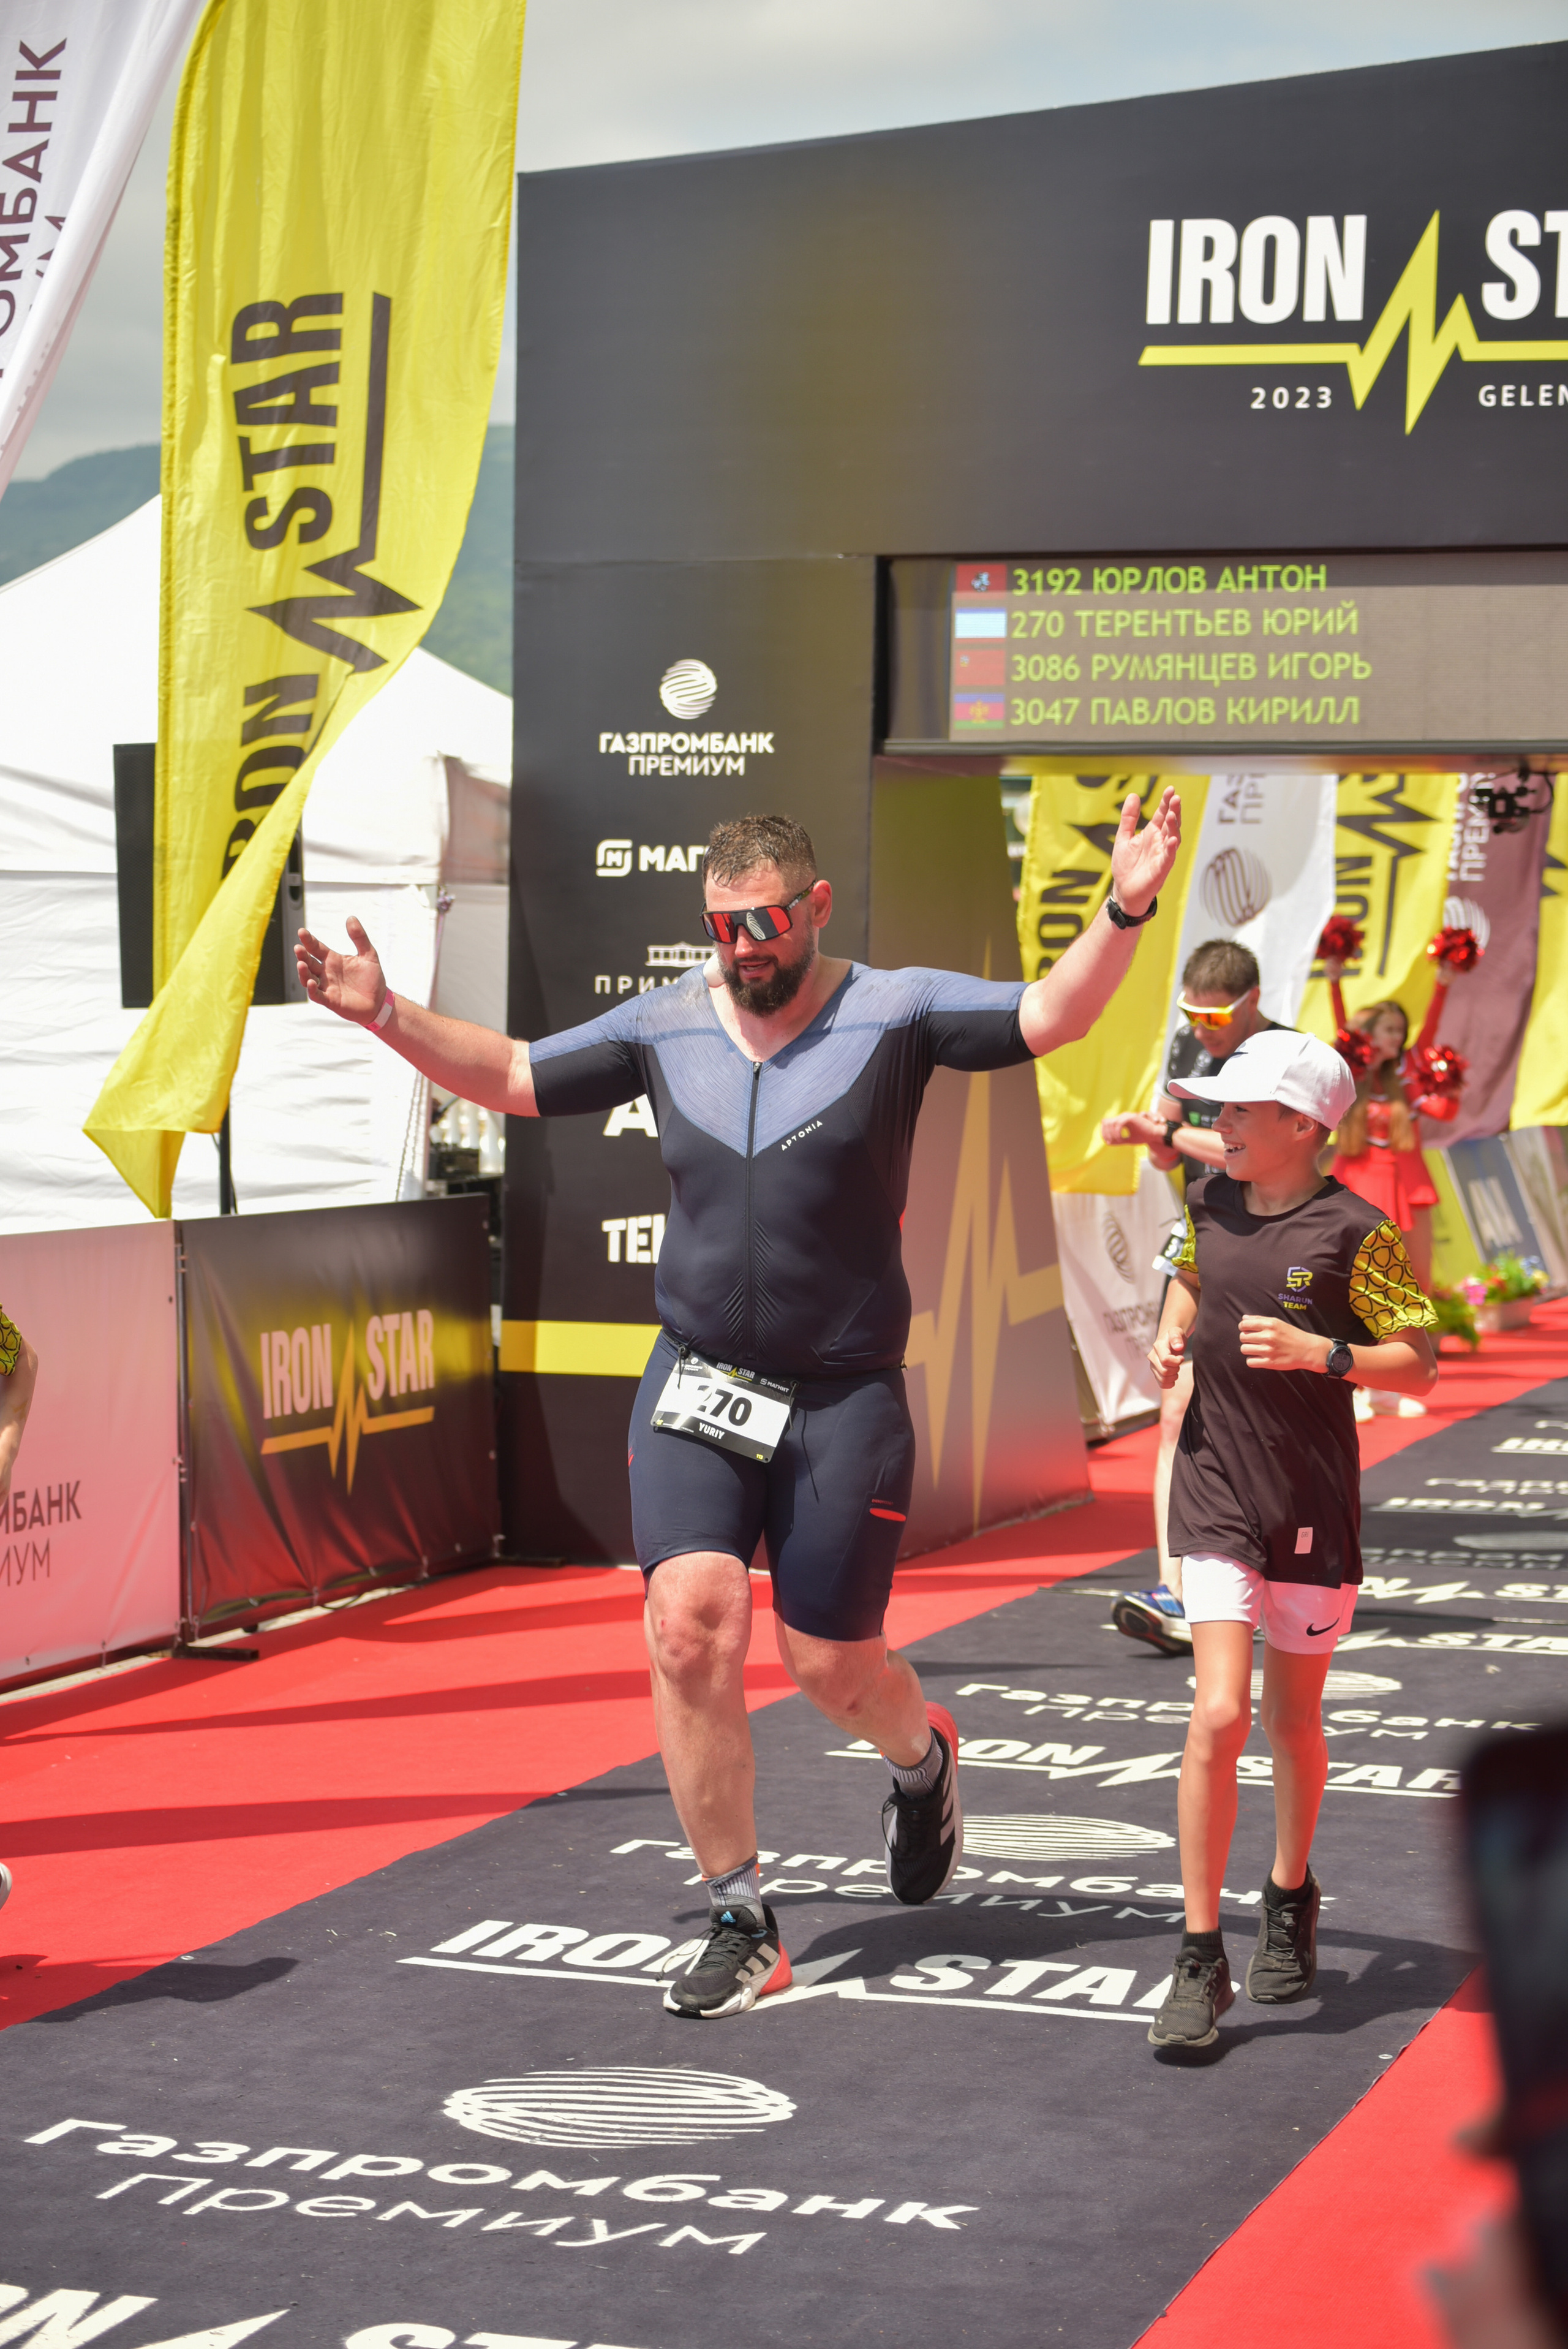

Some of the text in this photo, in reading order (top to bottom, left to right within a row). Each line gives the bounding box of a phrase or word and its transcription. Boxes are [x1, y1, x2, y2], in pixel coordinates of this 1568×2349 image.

[1146, 214, 1367, 324] IRON
[1251, 387, 1333, 409] 2023
[231, 292, 344, 551] STAR
[1012, 564, 1327, 596] 3192 ЮРЛОВ АНТОН
[1011, 600, 1359, 638] 270 ТЕРЕНТЬЕВ ЮРИЙ
[1011, 651, 1373, 687] 3086 РУМЯНЦЕВ ИГОРЬ
[1010, 697, 1360, 725] 3047 ПАВЛОВ КИРИЛЛ
[598, 732, 775, 754] ГАЗПРОМБАНК
[628, 755, 745, 776] ПРЕМИУМ
[639, 845, 709, 872] МАГ
[781, 1120, 823, 1151] APTONIA
[1278, 1293, 1313, 1305] SHARUN
[1283, 1301, 1307, 1311] TEAM
[261, 1309, 435, 1419] IRON STAR
[716, 1362, 755, 1379] IRON STAR
[697, 1385, 752, 1427] 270
[699, 1422, 725, 1440] YURIY
[890, 1953, 1242, 2008] STA
[23, 2118, 983, 2231] Газпромбанк
[95, 2172, 769, 2256] Премиум
